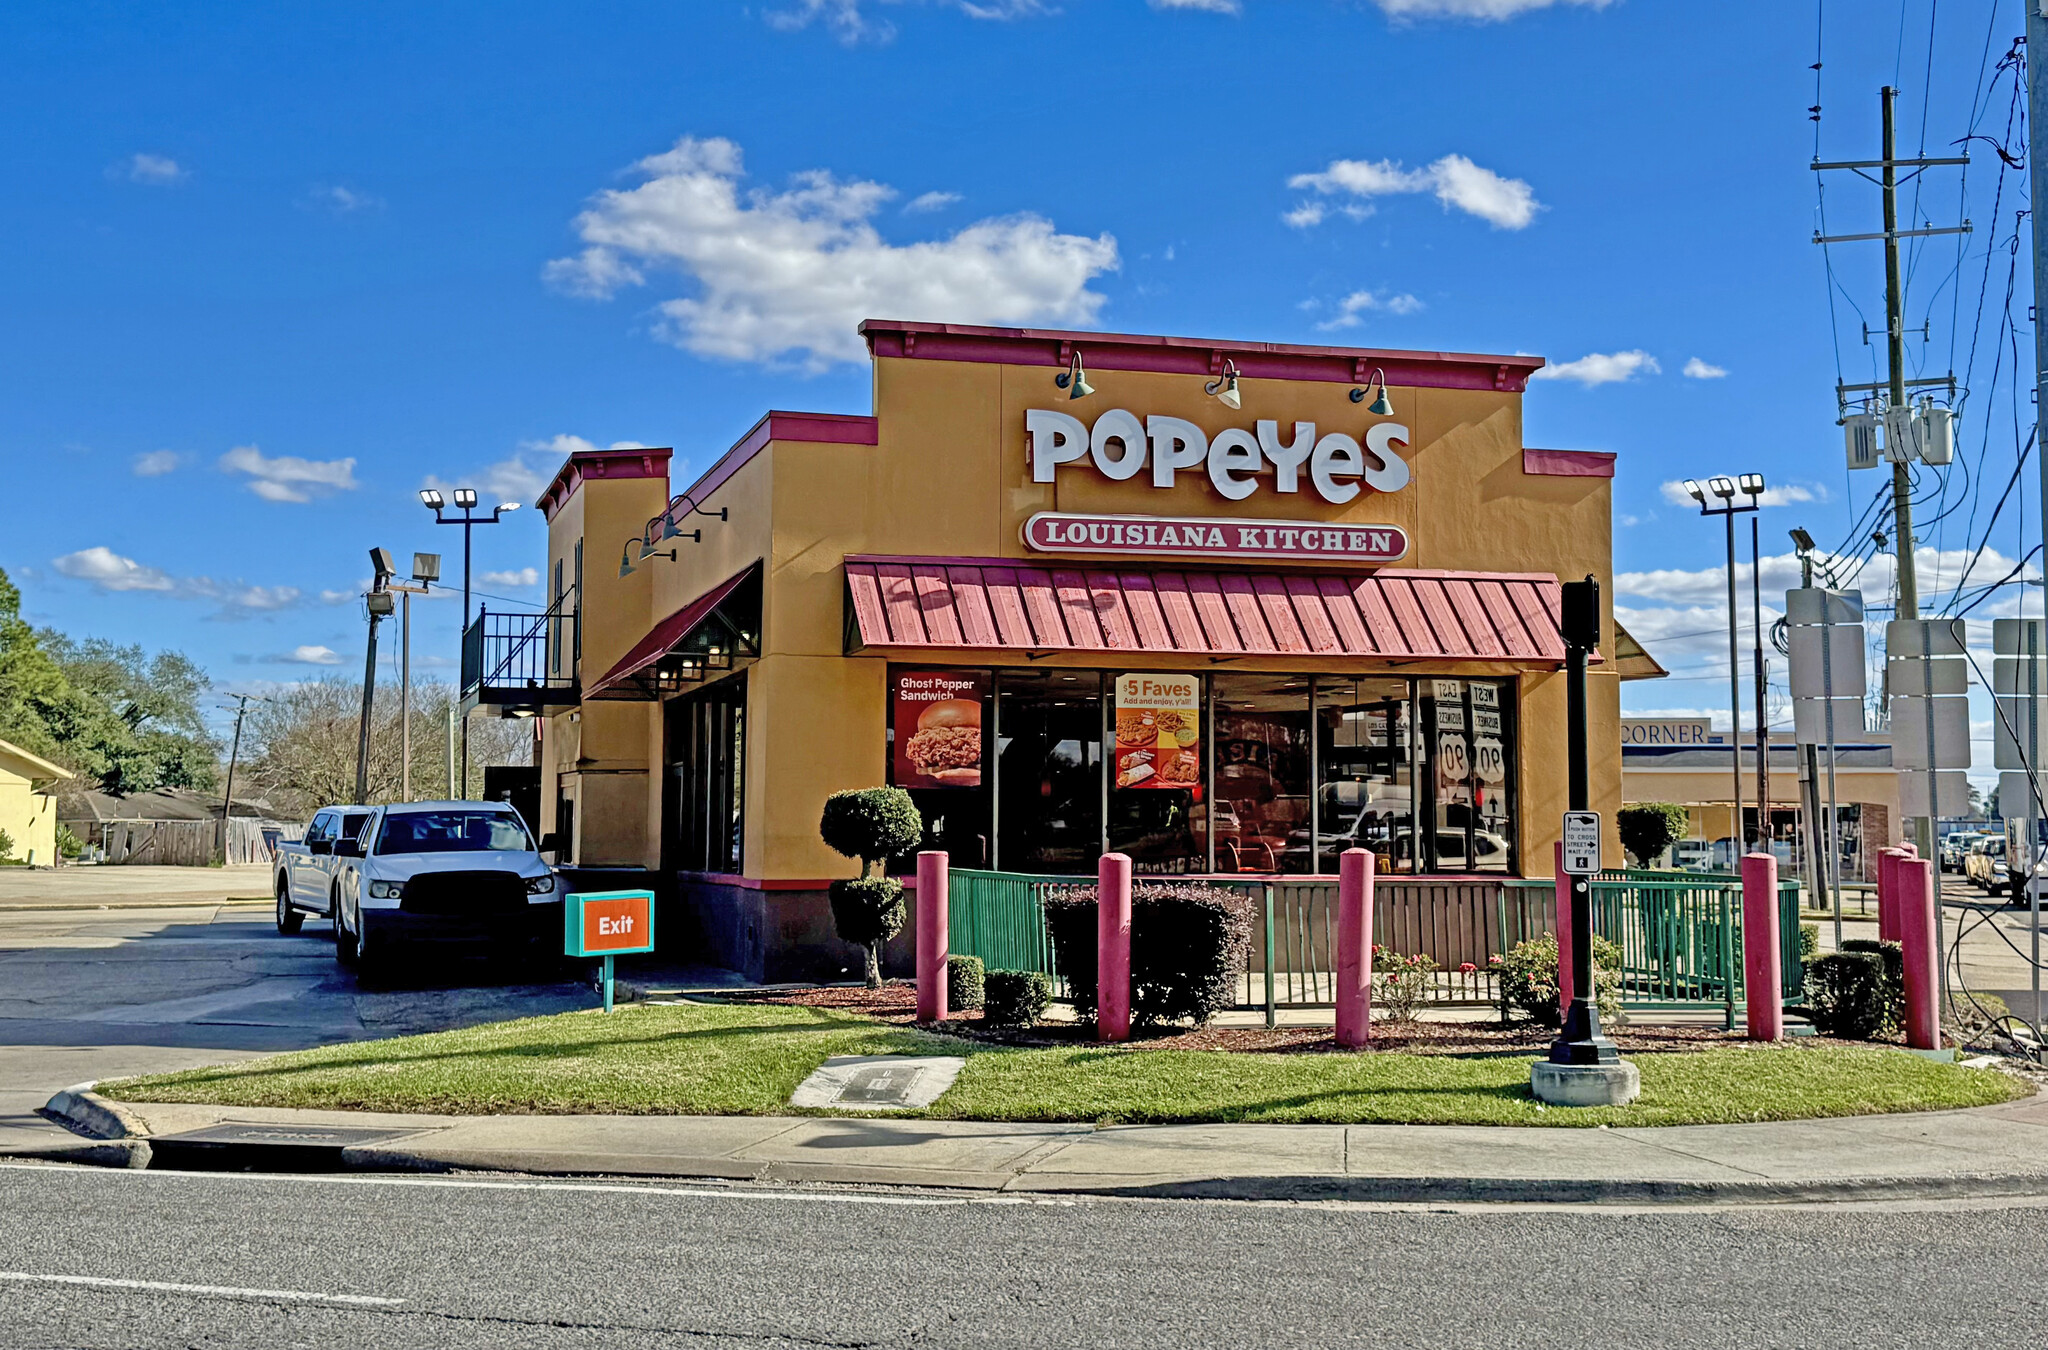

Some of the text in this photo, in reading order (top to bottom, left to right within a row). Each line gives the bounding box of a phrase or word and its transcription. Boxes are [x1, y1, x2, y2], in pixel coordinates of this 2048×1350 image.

[1046, 522, 1392, 552] LOUISIANA KITCHEN
[901, 678, 974, 690] Ghost Pepper
[1123, 680, 1192, 696] $5 Faves
[901, 690, 953, 700] Sandwich
[1621, 724, 1704, 744] CORNER
[599, 915, 633, 935] Exit
